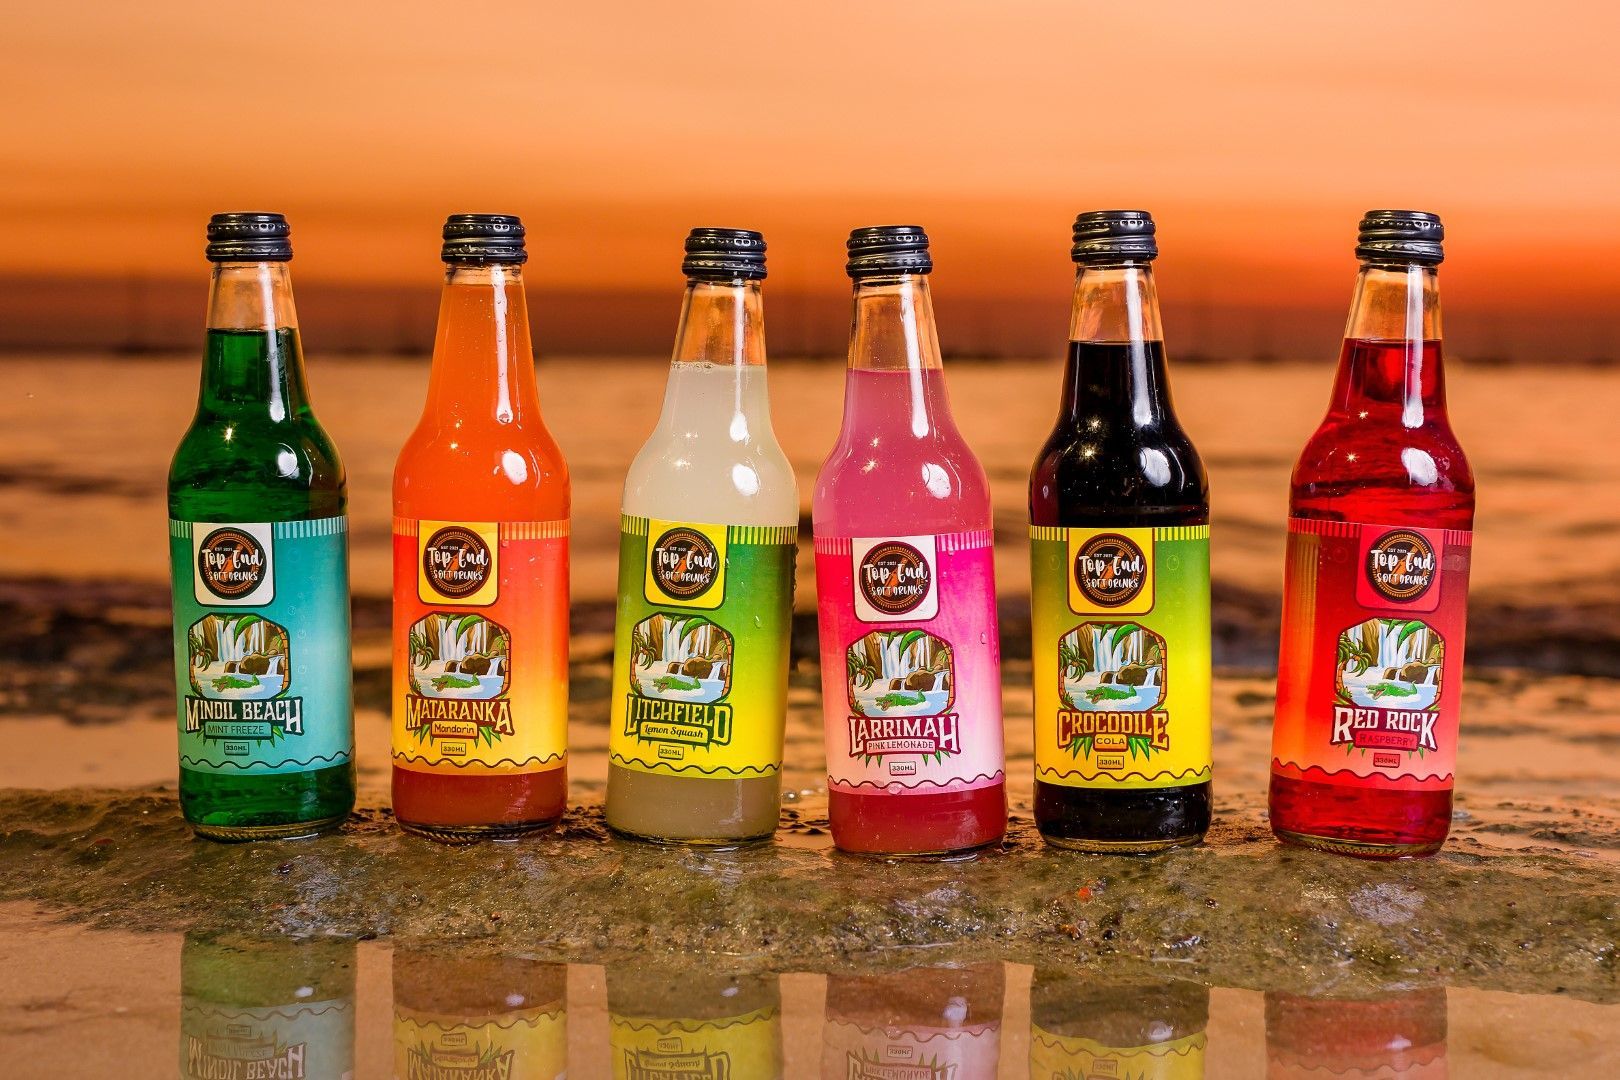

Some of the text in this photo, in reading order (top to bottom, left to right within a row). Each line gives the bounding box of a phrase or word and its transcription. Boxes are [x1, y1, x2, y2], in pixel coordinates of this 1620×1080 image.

[202, 549, 264, 569] Top End
[428, 547, 488, 568] Top End
[656, 548, 716, 570] Top End
[1079, 555, 1144, 576] Top End
[1371, 550, 1434, 572] Top End
[208, 571, 258, 582] SOFT DRINKS
[434, 570, 482, 580] SOFT DRINKS
[661, 570, 710, 584] SOFT DRINKS
[864, 562, 928, 584] Top End
[1086, 578, 1138, 588] SOFT DRINKS
[1376, 573, 1428, 586] SOFT DRINKS
[872, 584, 923, 596] SOFT DRINKS
[186, 698, 302, 733] MINDIL BEACH
[407, 697, 512, 733] MATARANKA
[626, 697, 731, 743] LITCHFIELD
[208, 726, 264, 734] MINT FREEZE
[434, 724, 474, 734] Mandarin
[645, 724, 704, 738] Lemon Squash
[850, 716, 958, 754] LARRIMAH
[1059, 711, 1168, 750] CROCODILE
[1332, 706, 1438, 750] RED ROCK
[868, 741, 933, 750] PINK LEMONADE
[1360, 734, 1414, 746] RASPBERRY
